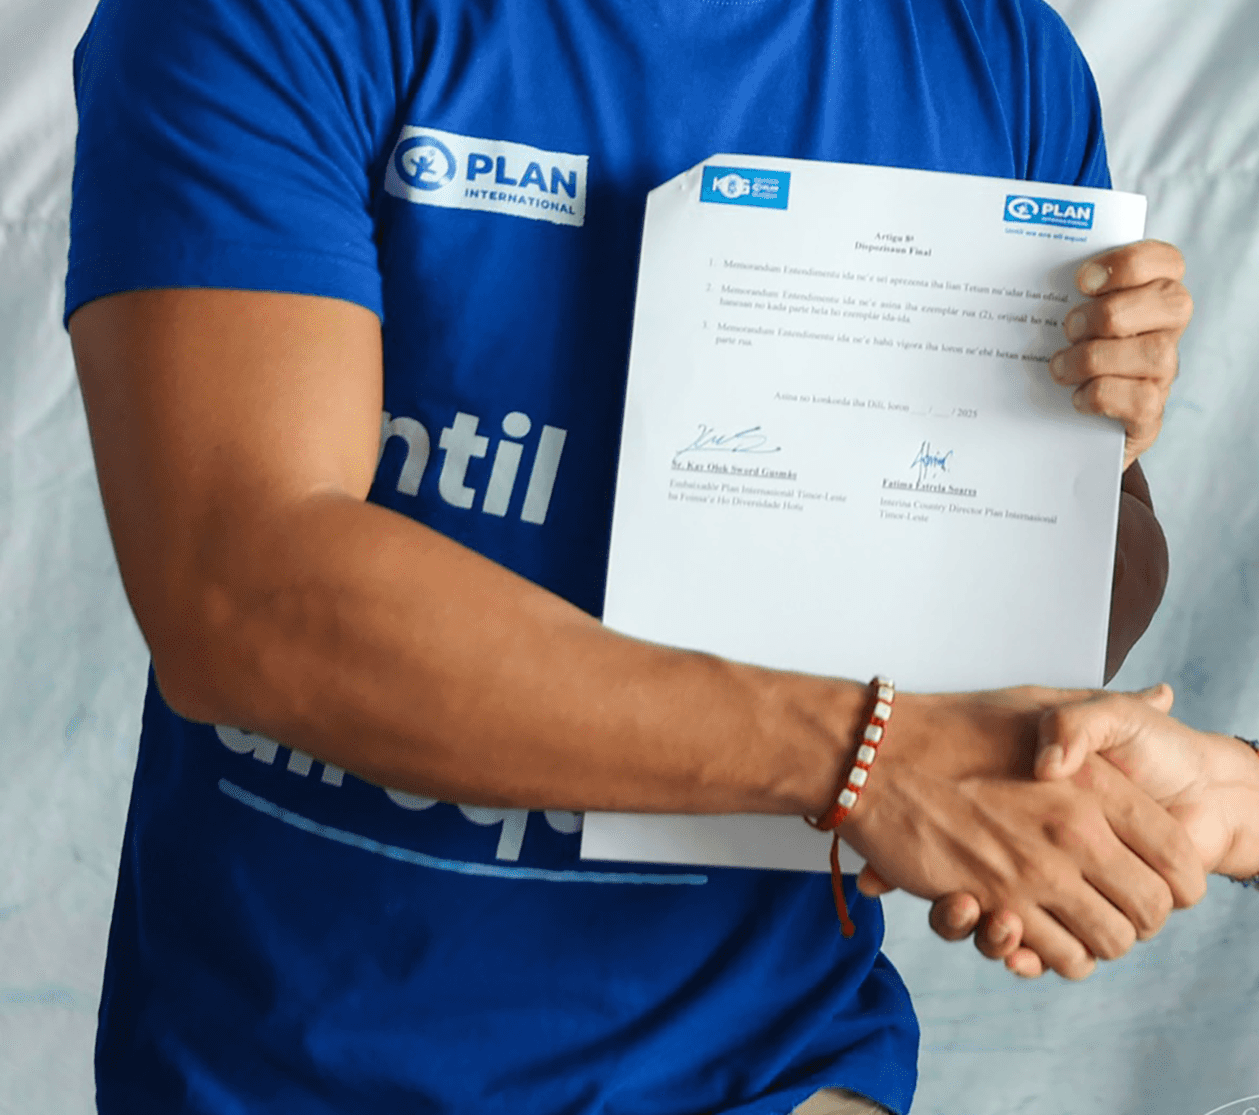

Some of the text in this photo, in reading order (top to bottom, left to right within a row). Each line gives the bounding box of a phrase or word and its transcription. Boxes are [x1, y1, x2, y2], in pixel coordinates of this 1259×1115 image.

[466, 152, 577, 199] PLAN
[465, 188, 576, 216] INTERNATIONAL
[1041, 203, 1091, 220] PLAN
[908, 246, 933, 258] Final
[956, 407, 978, 419] 2025
